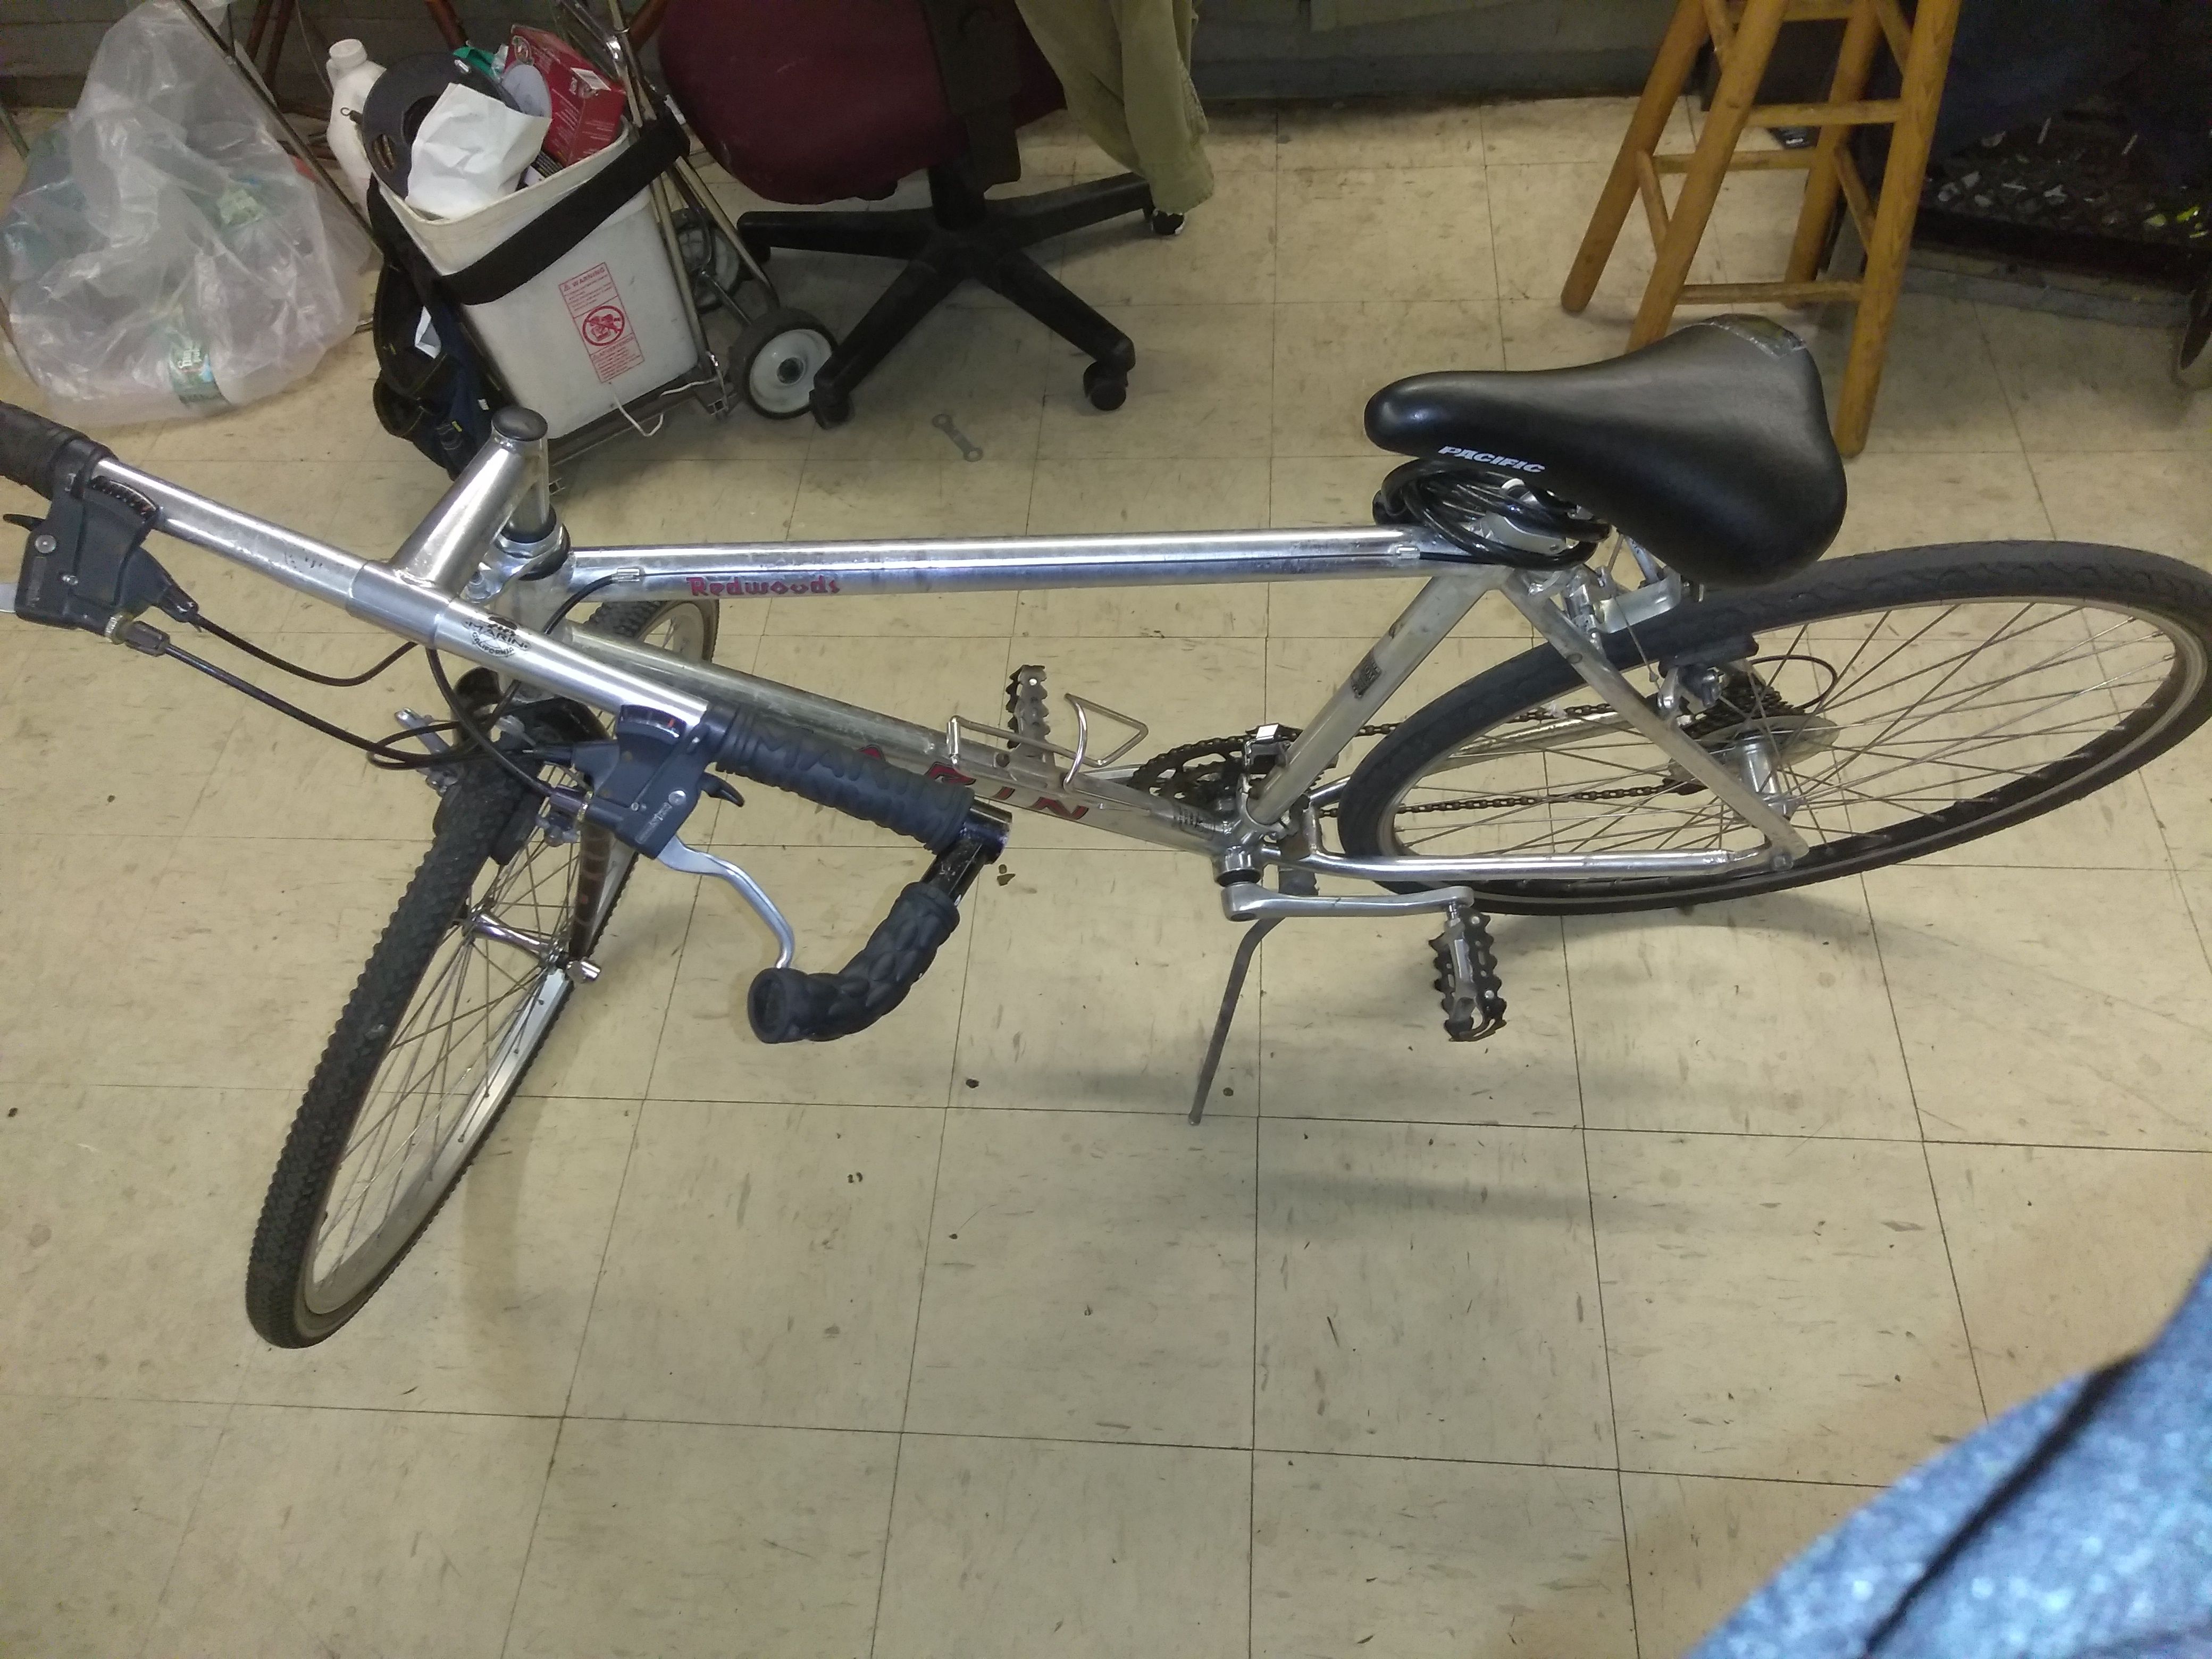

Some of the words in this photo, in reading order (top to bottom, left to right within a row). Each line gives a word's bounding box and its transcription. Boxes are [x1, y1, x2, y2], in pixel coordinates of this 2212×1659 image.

[1437, 445, 1546, 473] PACIFIC
[686, 575, 841, 597] Redwoods
[472, 632, 514, 655] CALIFORNIA
